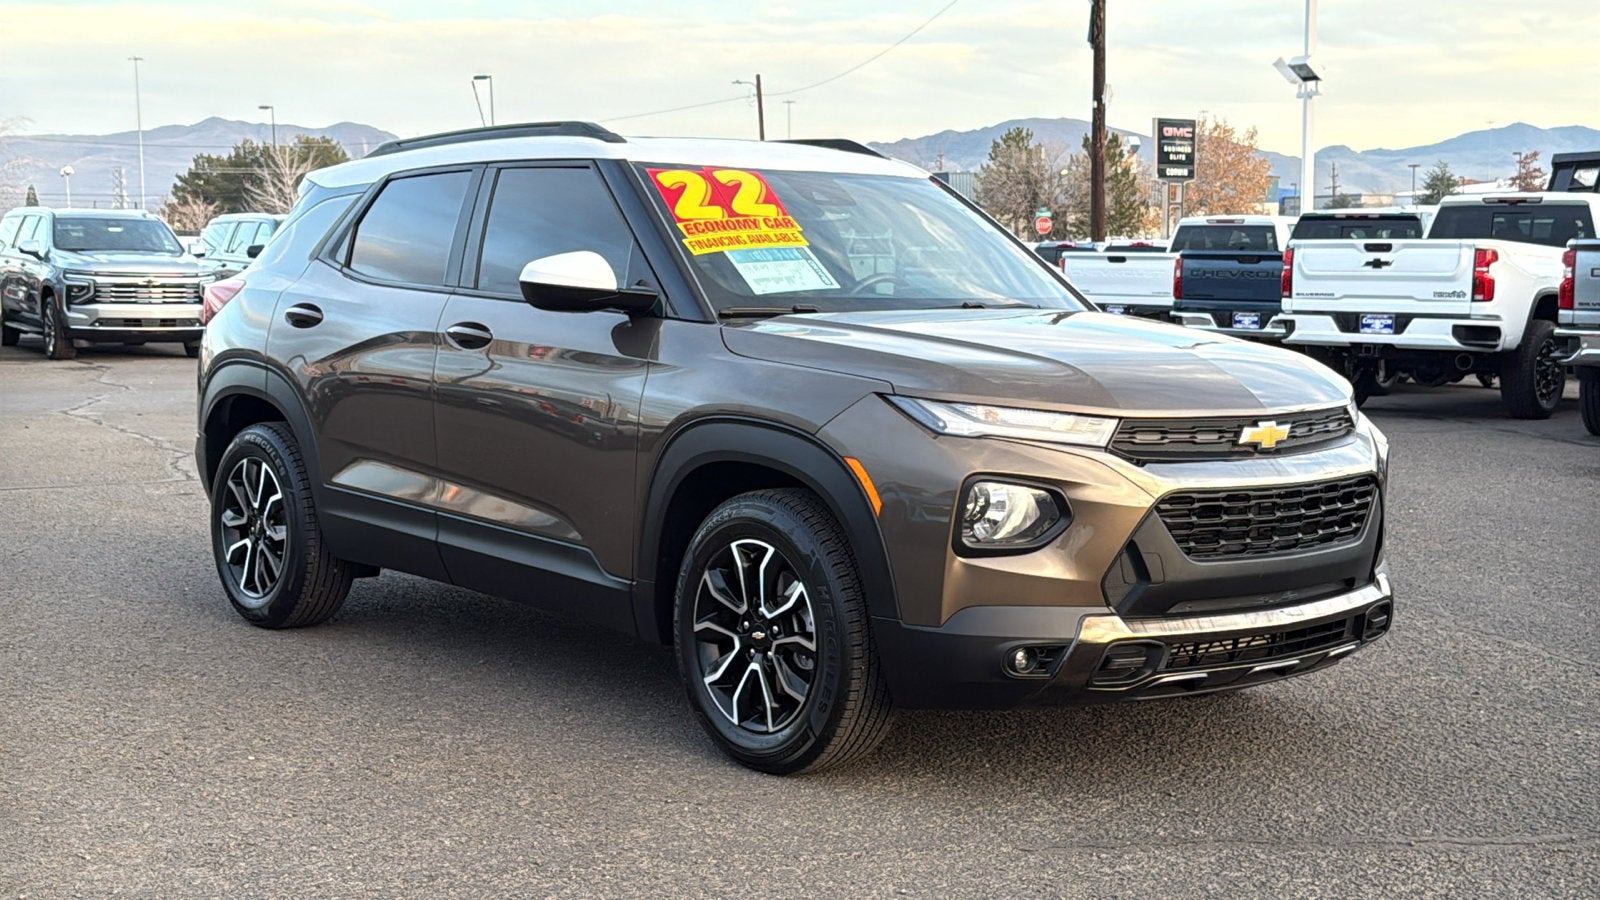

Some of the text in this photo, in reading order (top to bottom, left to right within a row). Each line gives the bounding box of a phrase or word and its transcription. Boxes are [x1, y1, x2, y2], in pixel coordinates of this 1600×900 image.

[1162, 127, 1193, 138] GMC
[656, 169, 780, 220] 22
[683, 217, 796, 236] ECONOMY CAR
[1036, 221, 1052, 229] STOP
[688, 232, 802, 252] FINANCING AVAILABLE
[1190, 269, 1281, 279] CHEVROL
[244, 434, 286, 477] HERCULES
[816, 585, 838, 714] HERCULES
